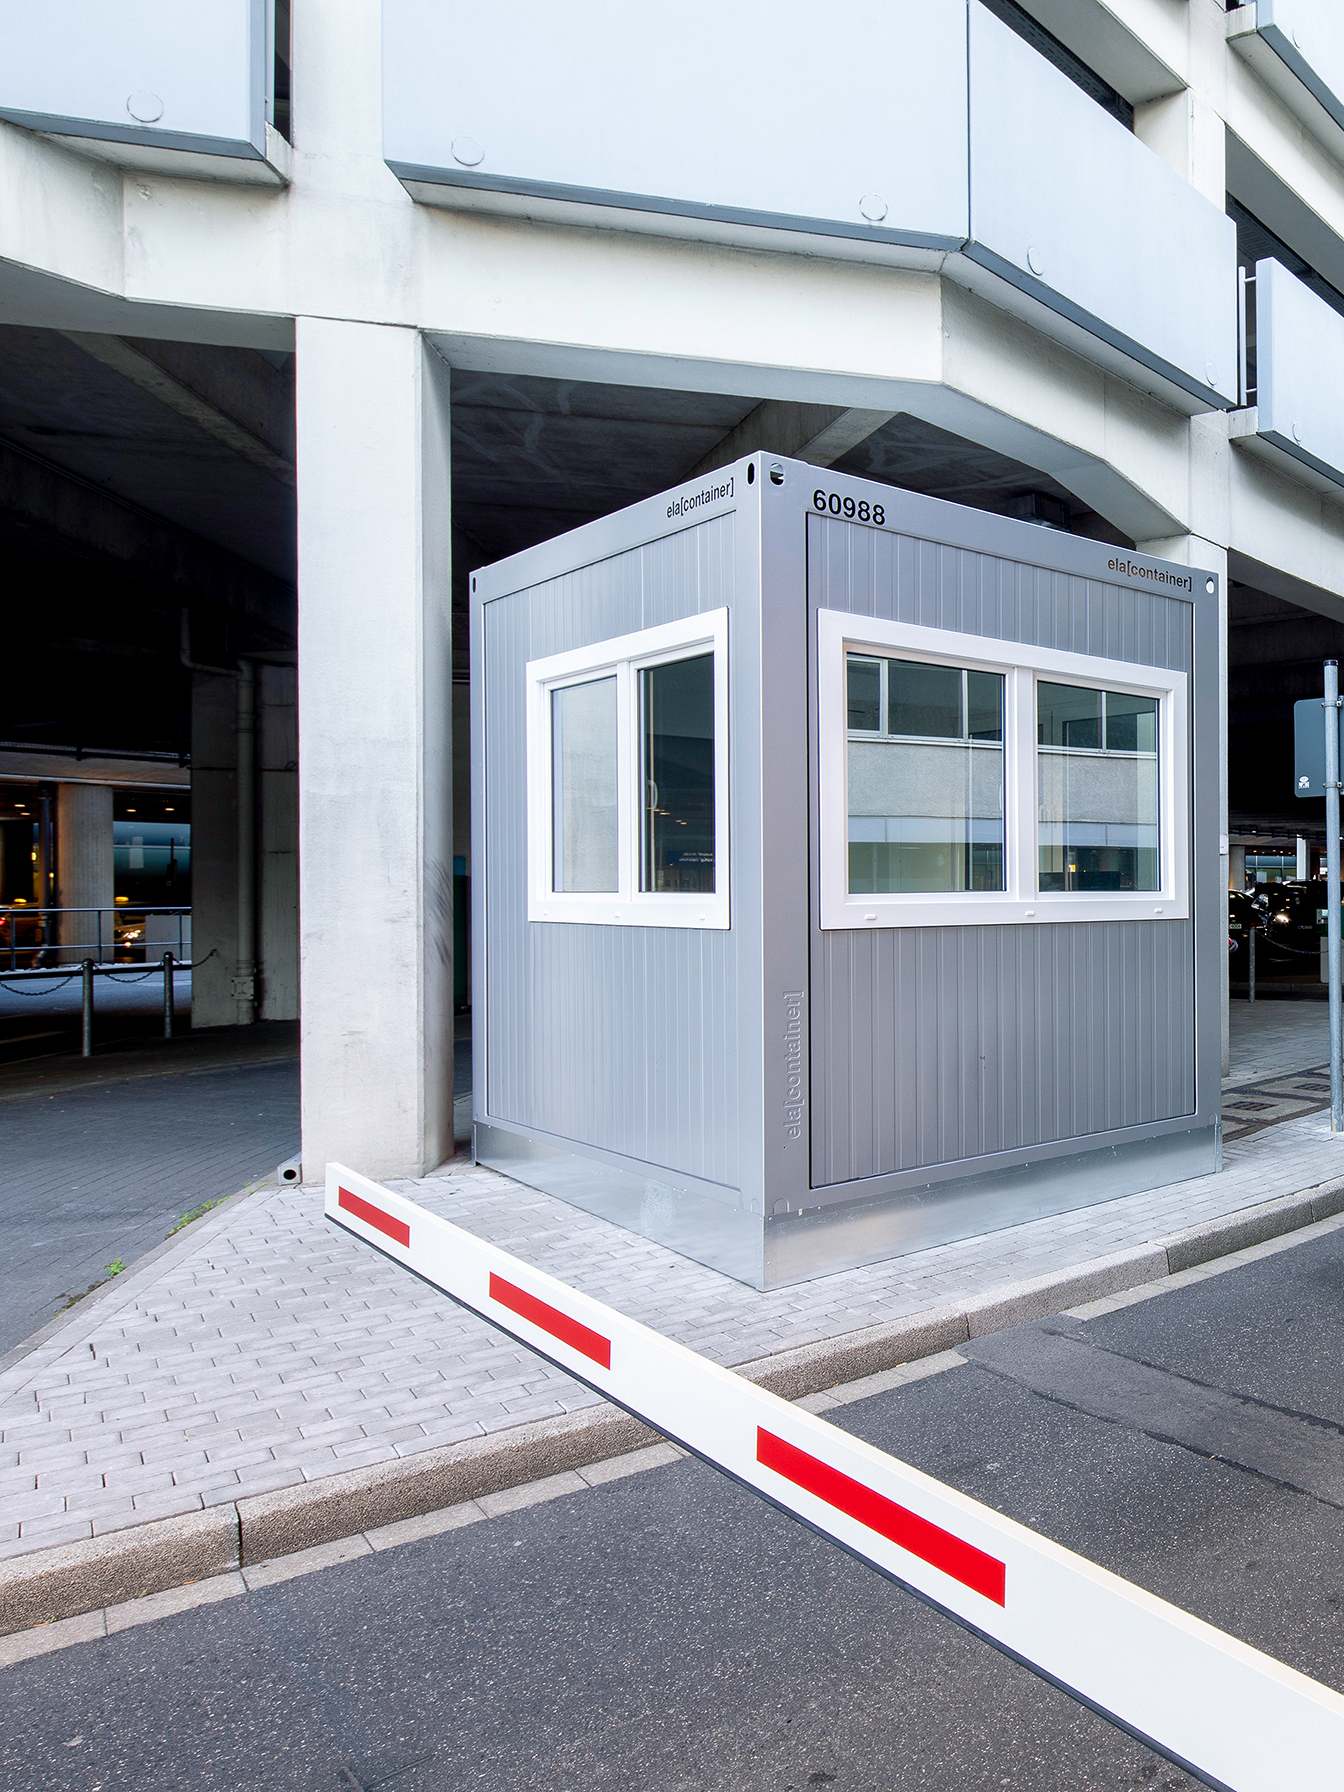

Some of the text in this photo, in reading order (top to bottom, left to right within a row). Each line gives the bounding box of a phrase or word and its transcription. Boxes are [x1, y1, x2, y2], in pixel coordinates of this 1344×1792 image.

[666, 476, 734, 518] ela[container]
[813, 489, 886, 526] 60988
[1107, 557, 1192, 592] ela[container]
[783, 990, 805, 1140] ela[container]
